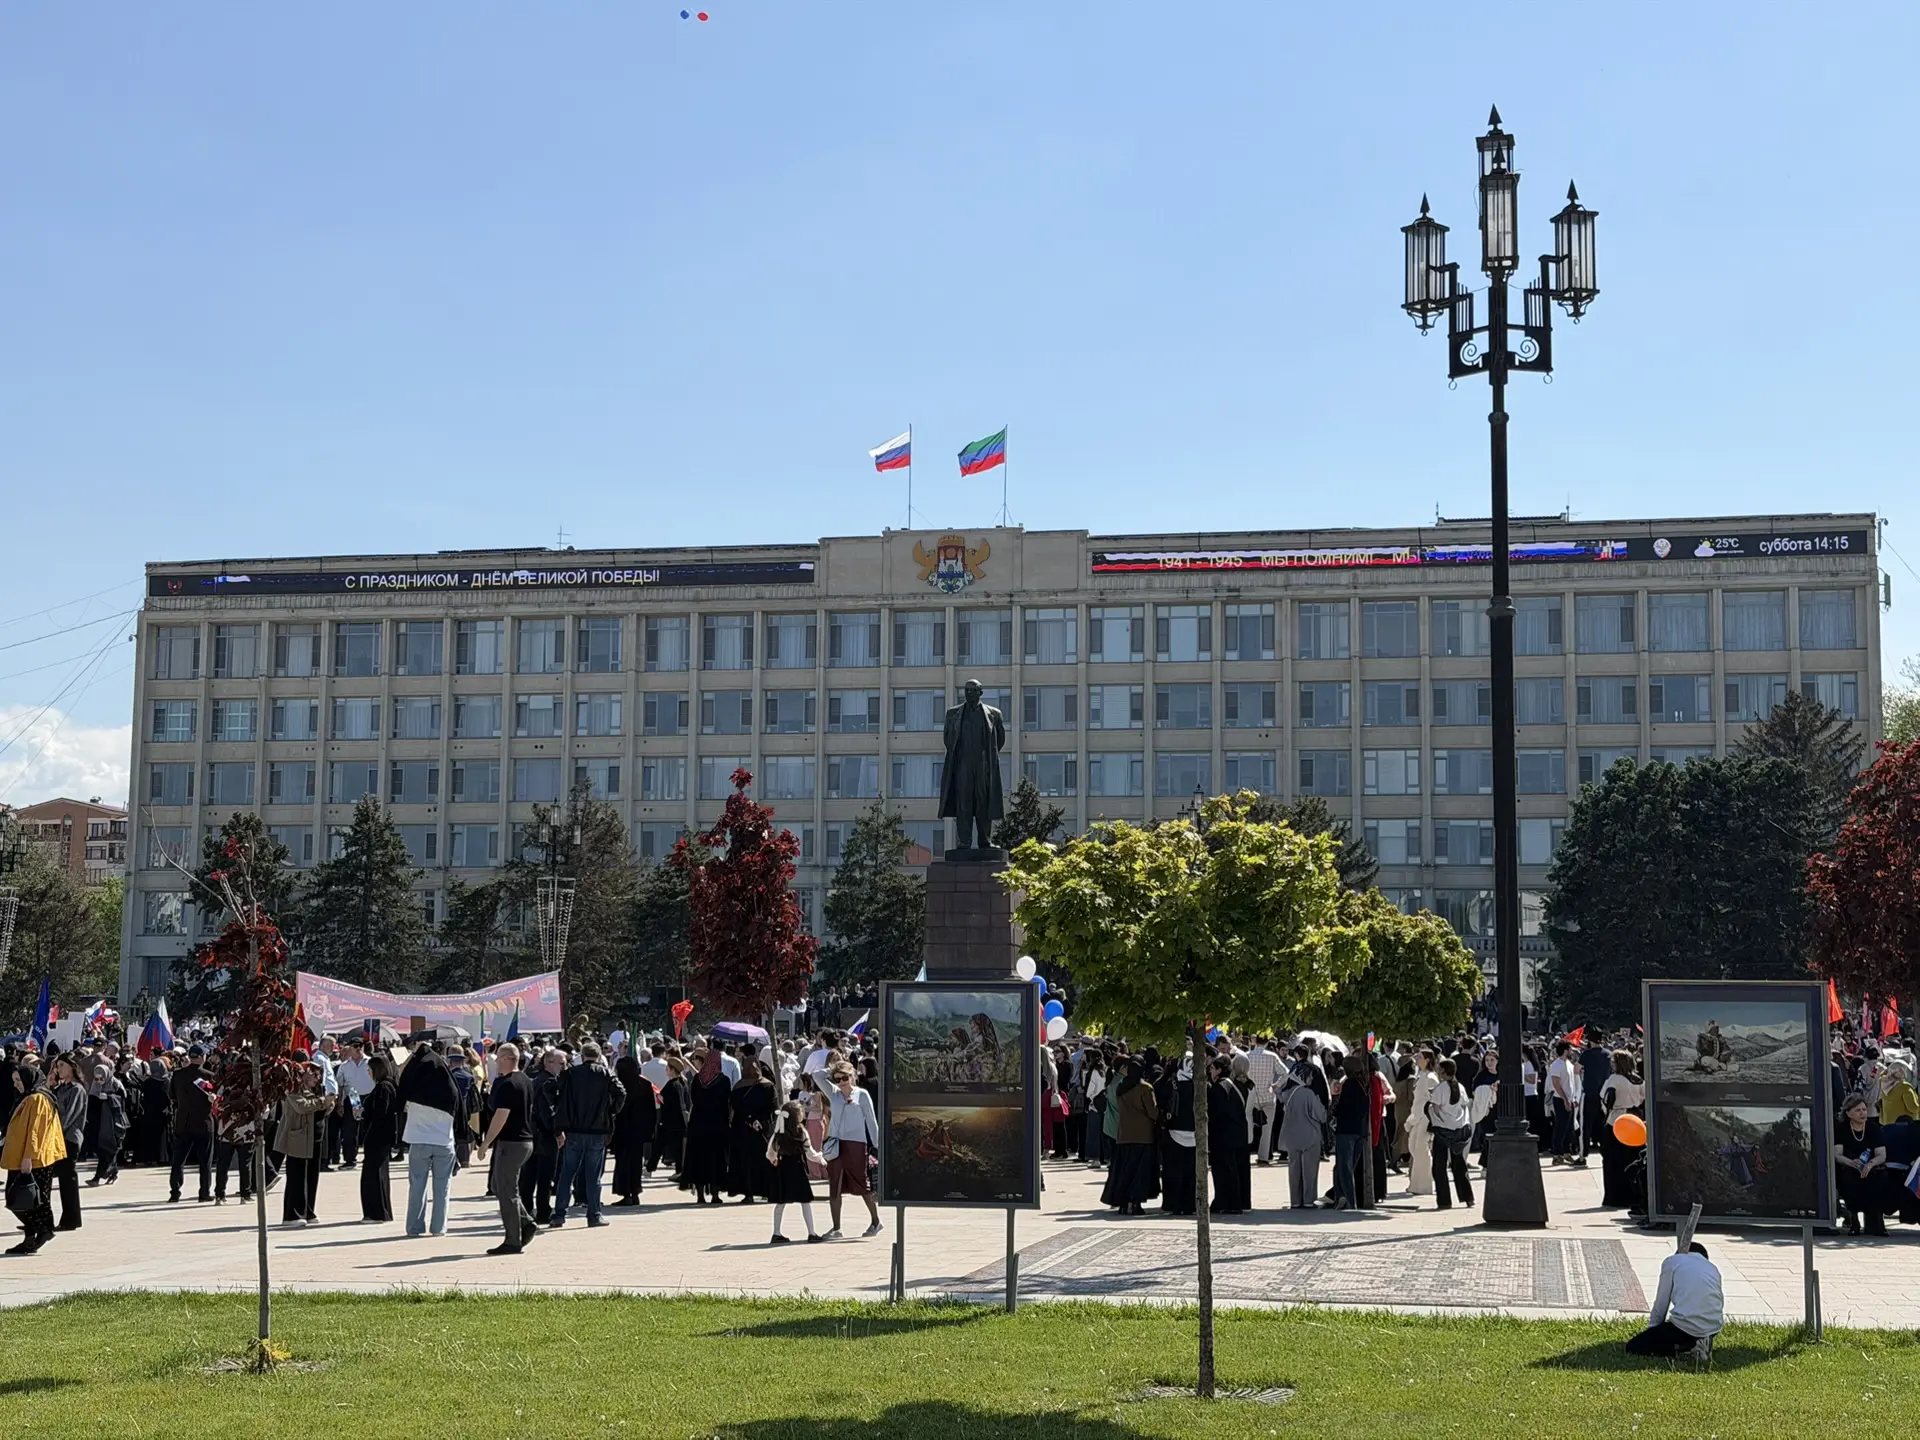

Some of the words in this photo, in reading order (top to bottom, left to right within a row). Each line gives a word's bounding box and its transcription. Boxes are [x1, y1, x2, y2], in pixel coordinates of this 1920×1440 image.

[1759, 538, 1811, 554] суббота
[1814, 536, 1849, 550] 14:15
[1158, 556, 1190, 568] 1941
[1207, 554, 1243, 567] 1945
[345, 576, 355, 589] С
[360, 574, 458, 589] ПРАЗДНИКОМ
[471, 571, 514, 587] ДНЁМ
[518, 569, 587, 585] ВЕЛИКОЙ
[592, 570, 660, 585] ПОБЕДЫ!
